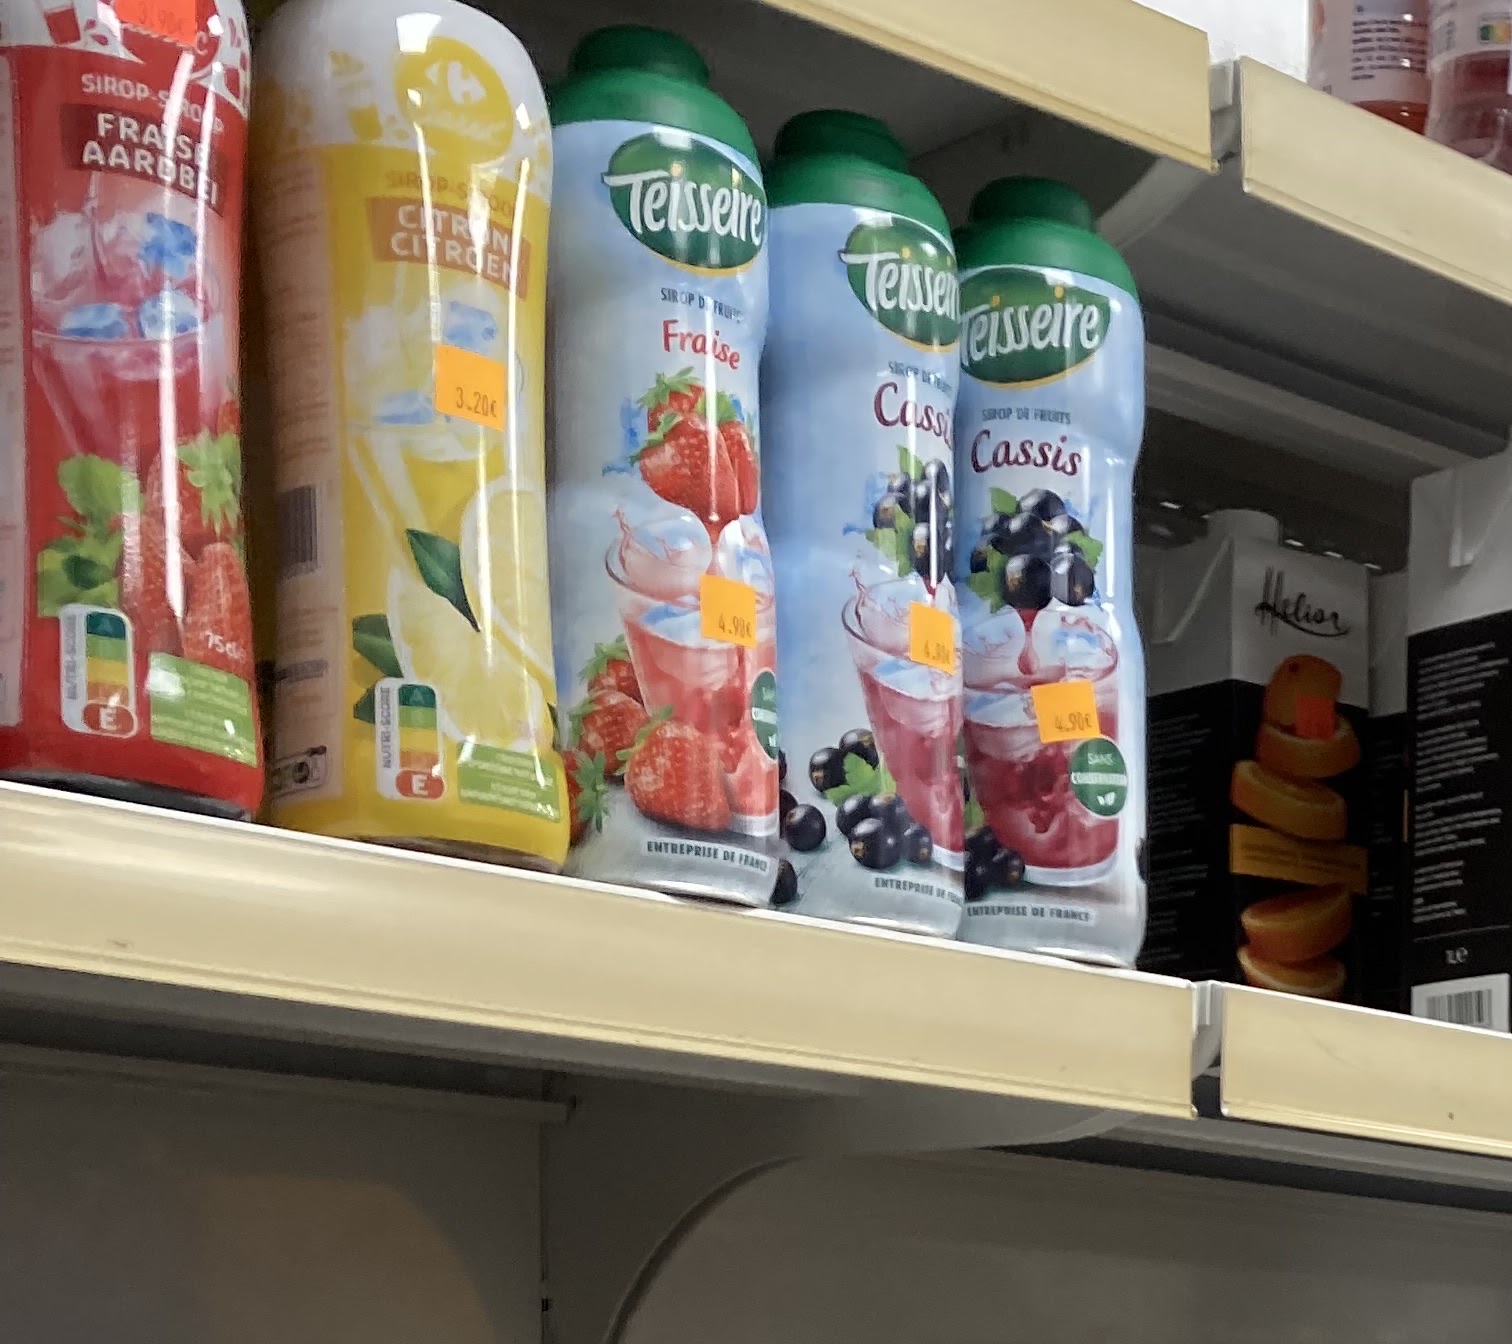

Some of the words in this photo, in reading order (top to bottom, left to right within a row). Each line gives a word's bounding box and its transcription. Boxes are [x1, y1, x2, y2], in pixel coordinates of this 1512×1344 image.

[602, 169, 764, 247] Teisseire
[661, 318, 741, 370] Fraise
[971, 430, 1082, 477] Cassis
[646, 839, 719, 860] ENTREPRISE
